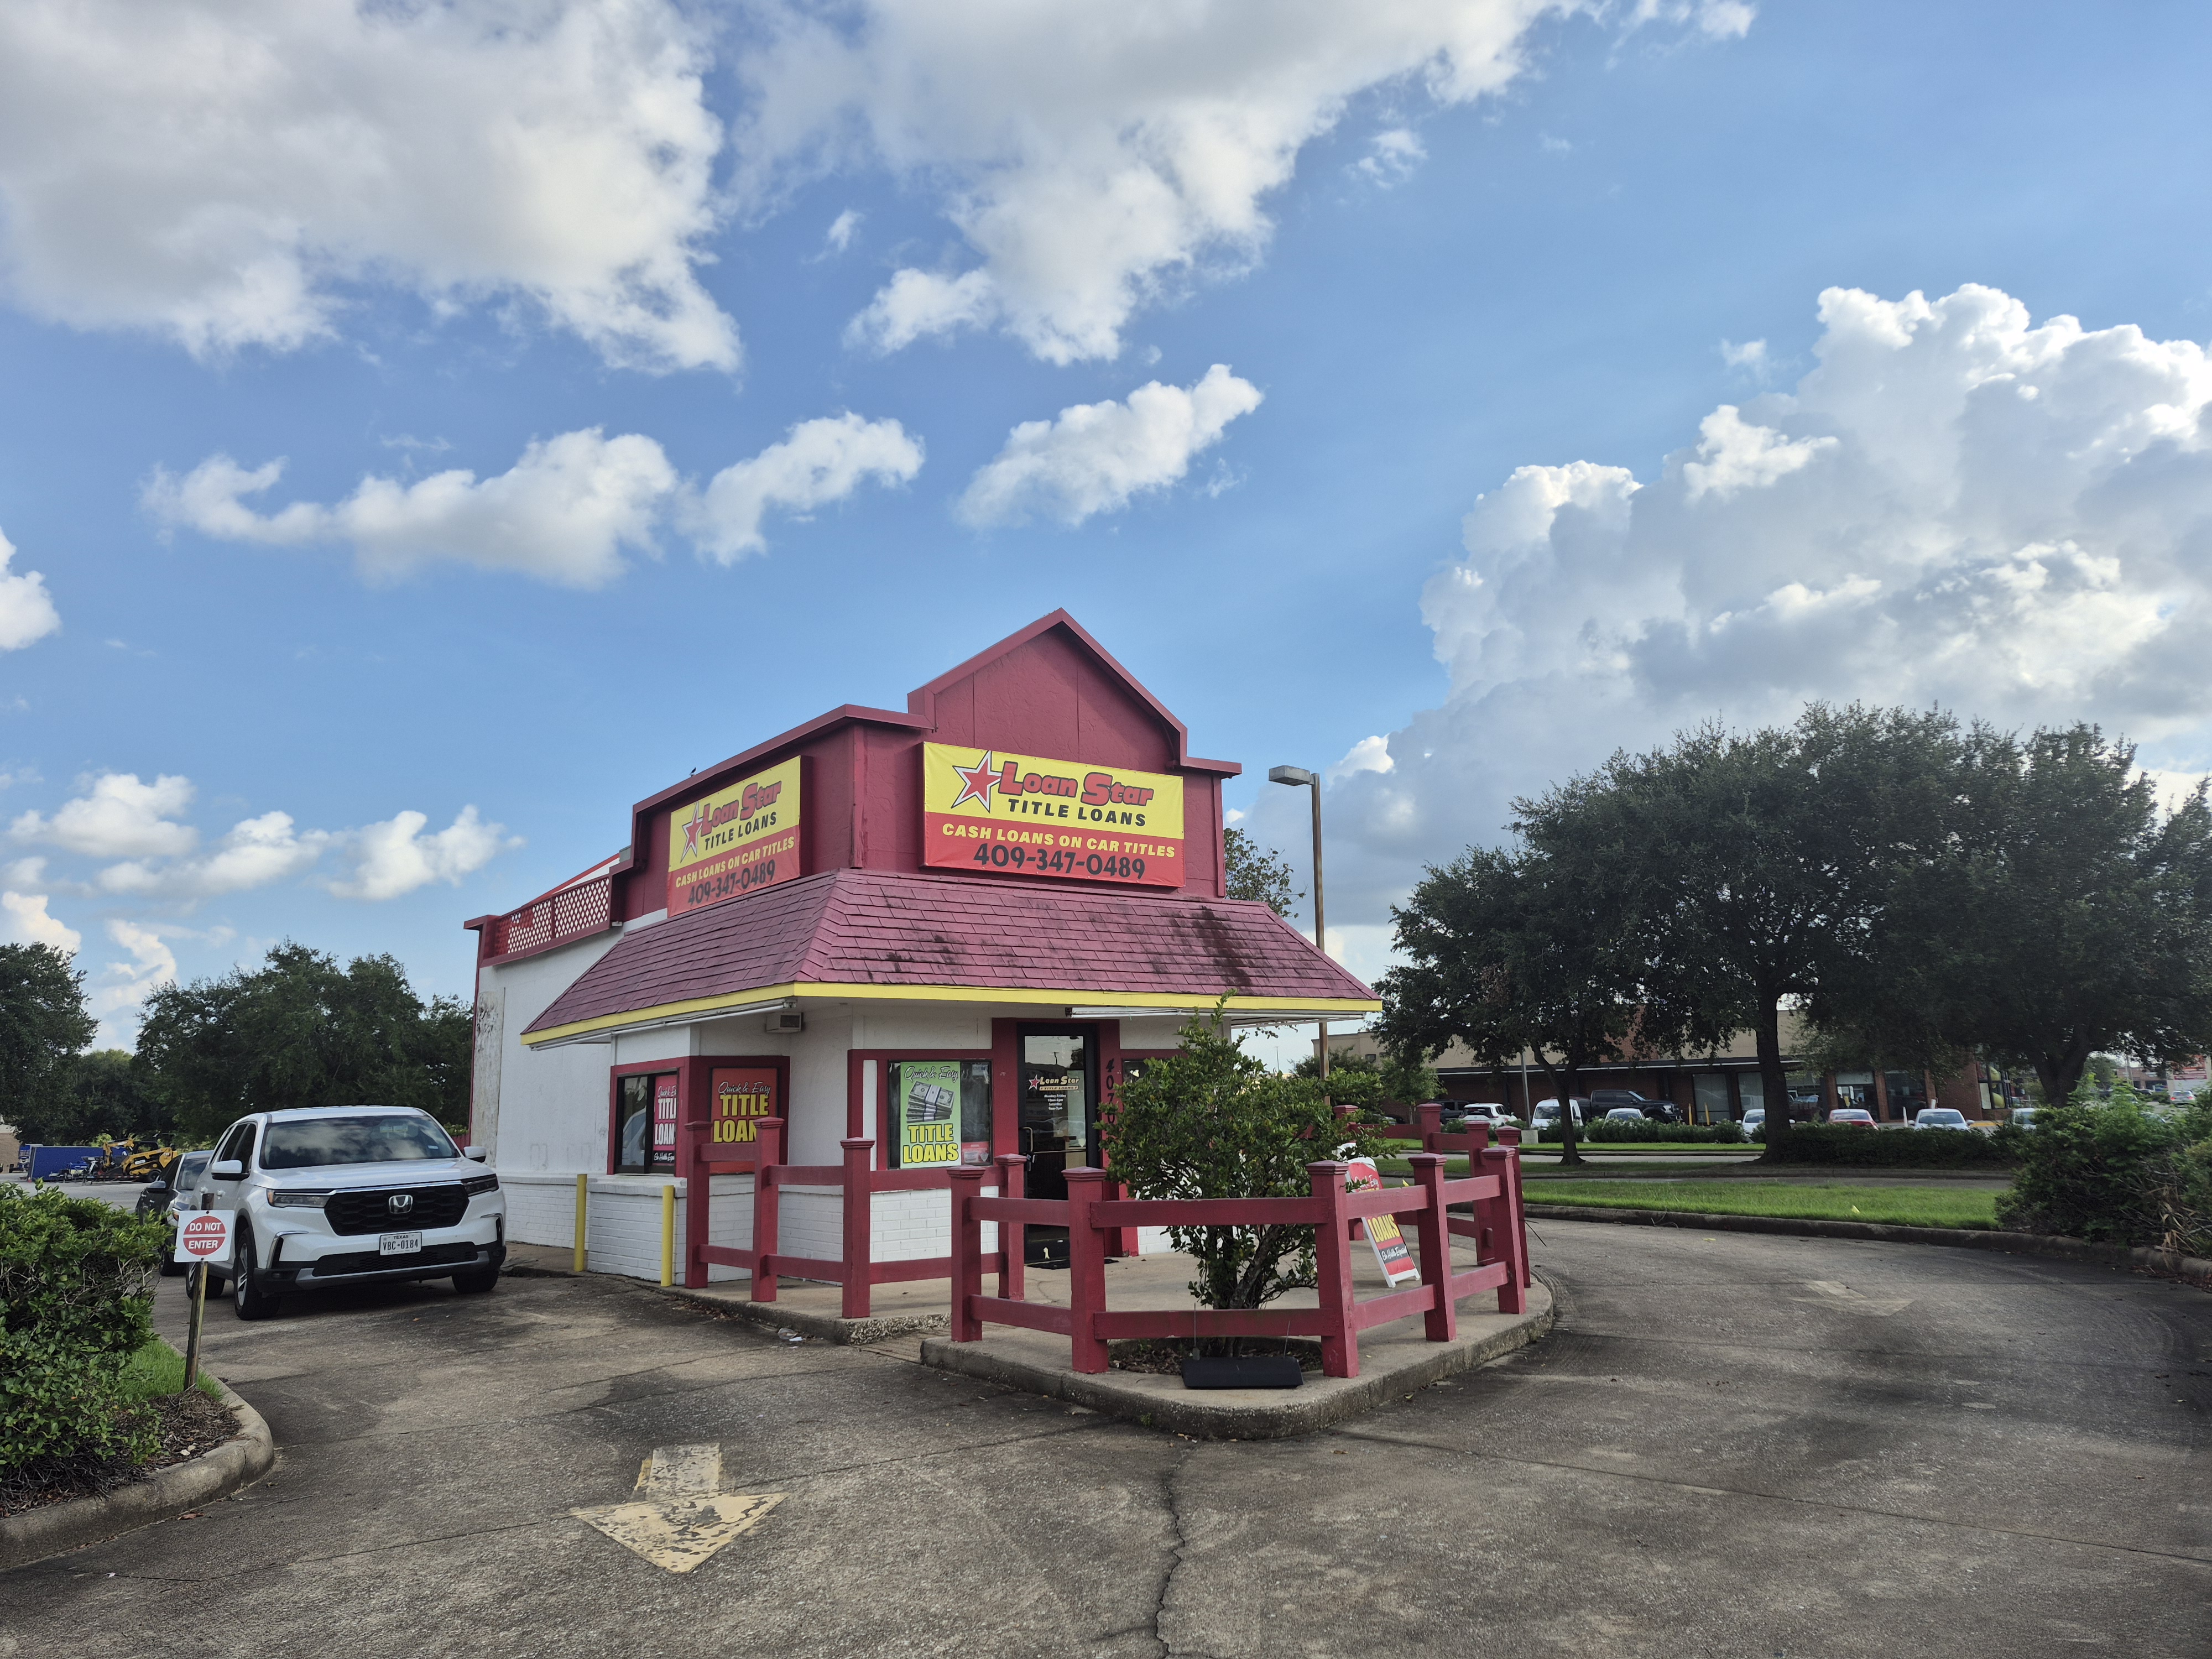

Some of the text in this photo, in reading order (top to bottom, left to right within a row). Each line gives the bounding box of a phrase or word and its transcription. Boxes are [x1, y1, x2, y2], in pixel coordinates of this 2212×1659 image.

[998, 761, 1154, 807] Loan Star
[701, 781, 781, 837] Loan Star
[1008, 799, 1146, 826] TITLE LOANS
[705, 812, 776, 851] TITLE LOANS
[942, 823, 1175, 858] CASH LOANS ON CAR TITLES
[676, 836, 794, 888] CASH LOANS ON CAR TITLES
[973, 843, 1145, 879] 409-347-0489
[688, 859, 775, 906] 409-347-0489
[904, 1066, 959, 1082] Quick & Easy
[1040, 1076, 1079, 1085] Loan Star
[718, 1081, 771, 1096] Quick & Easy
[719, 1094, 769, 1116] TITLE
[655, 1123, 675, 1145] LOAN
[713, 1119, 757, 1143] LOAN
[907, 1124, 953, 1143] TITLE
[903, 1143, 958, 1164] LOANS
[189, 1222, 221, 1232] DO NOT
[1368, 1213, 1400, 1243] LOANS
[188, 1240, 218, 1249] ENTER
